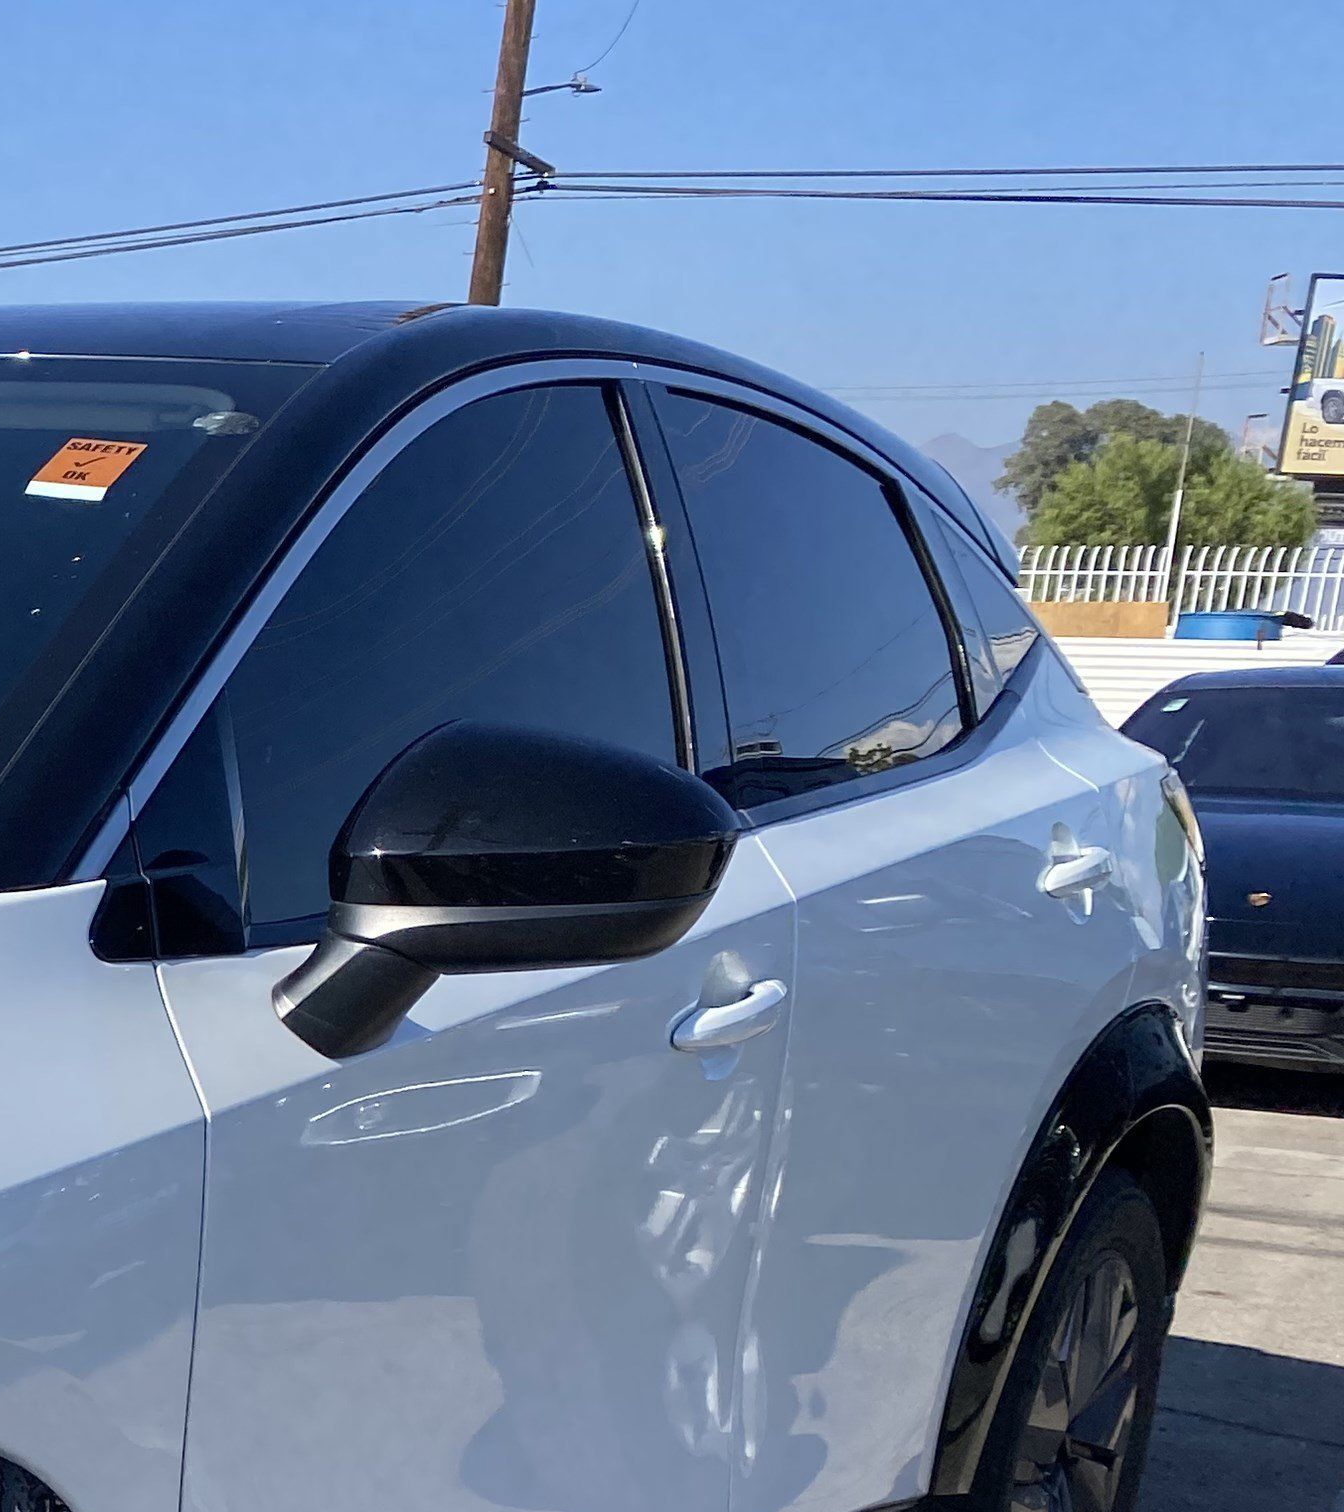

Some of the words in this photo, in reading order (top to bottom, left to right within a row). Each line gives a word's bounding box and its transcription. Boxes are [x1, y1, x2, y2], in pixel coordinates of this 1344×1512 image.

[1302, 422, 1319, 434] Lo
[66, 441, 140, 456] SAFETY
[62, 470, 90, 481] OK
